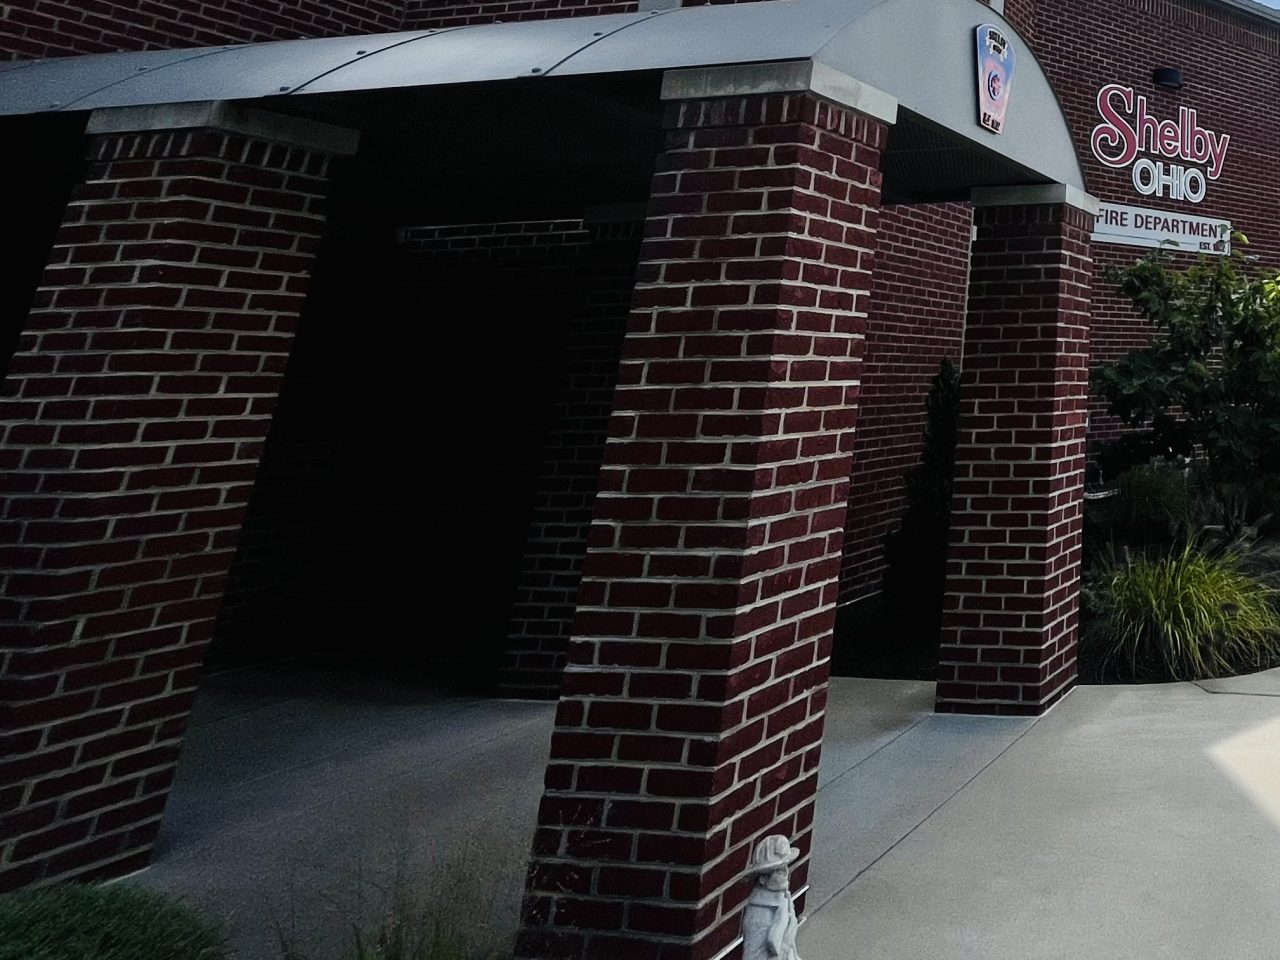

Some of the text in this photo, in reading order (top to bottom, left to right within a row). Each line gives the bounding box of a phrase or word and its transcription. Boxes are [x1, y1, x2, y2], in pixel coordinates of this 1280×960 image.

[1091, 83, 1230, 180] Shelby
[1132, 158, 1206, 203] OHIO
[1096, 208, 1129, 227] FIRE
